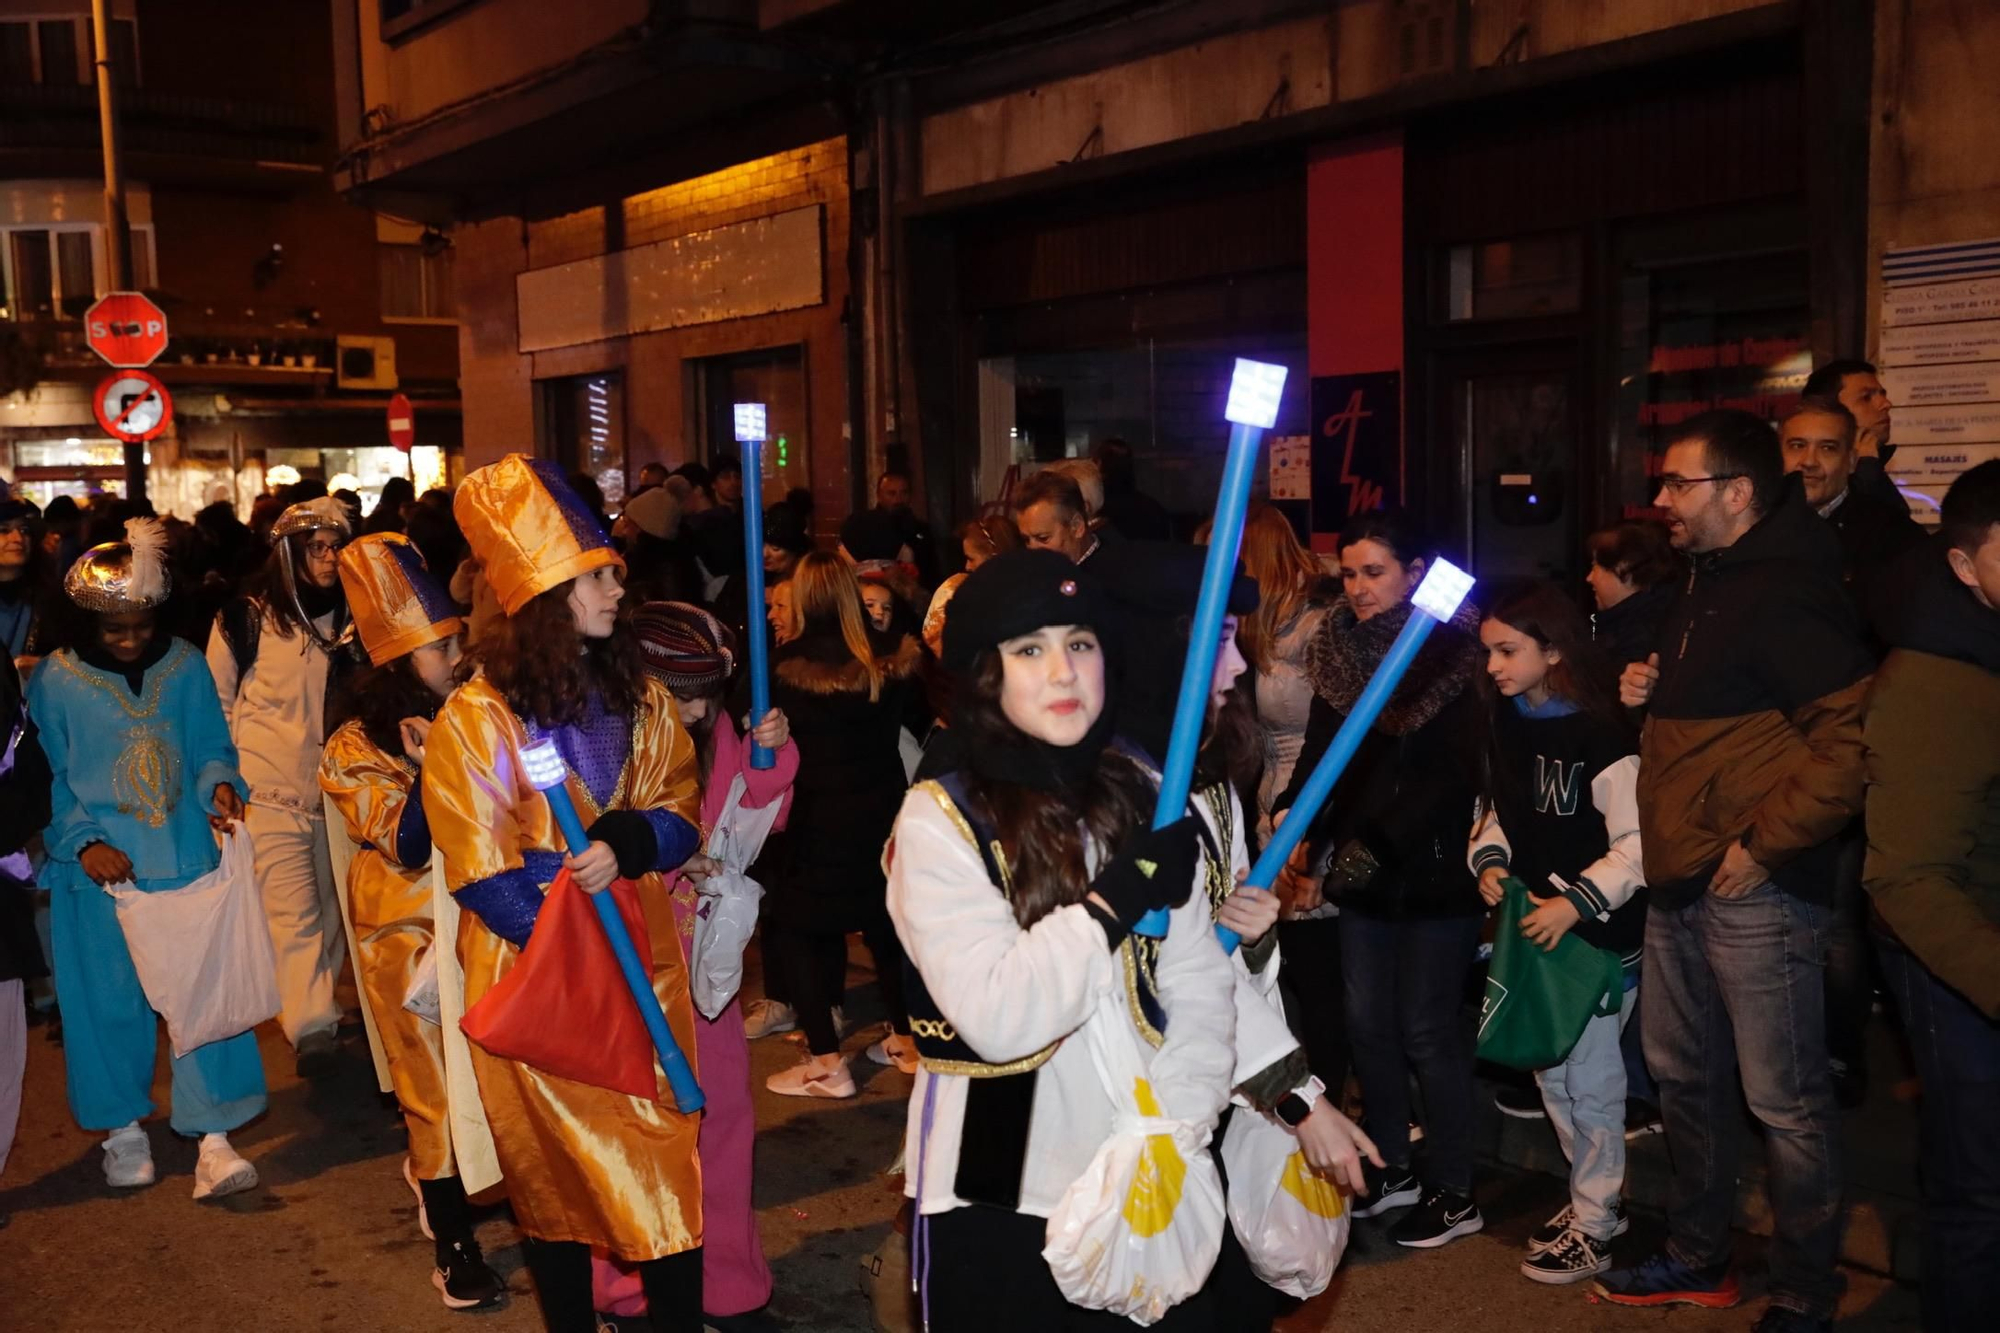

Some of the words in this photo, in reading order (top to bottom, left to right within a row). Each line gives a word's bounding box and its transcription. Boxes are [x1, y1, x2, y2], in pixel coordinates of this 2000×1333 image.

[91, 320, 162, 338] SOP
[1924, 455, 1968, 464] MASAJES
[1534, 754, 1584, 816] W
